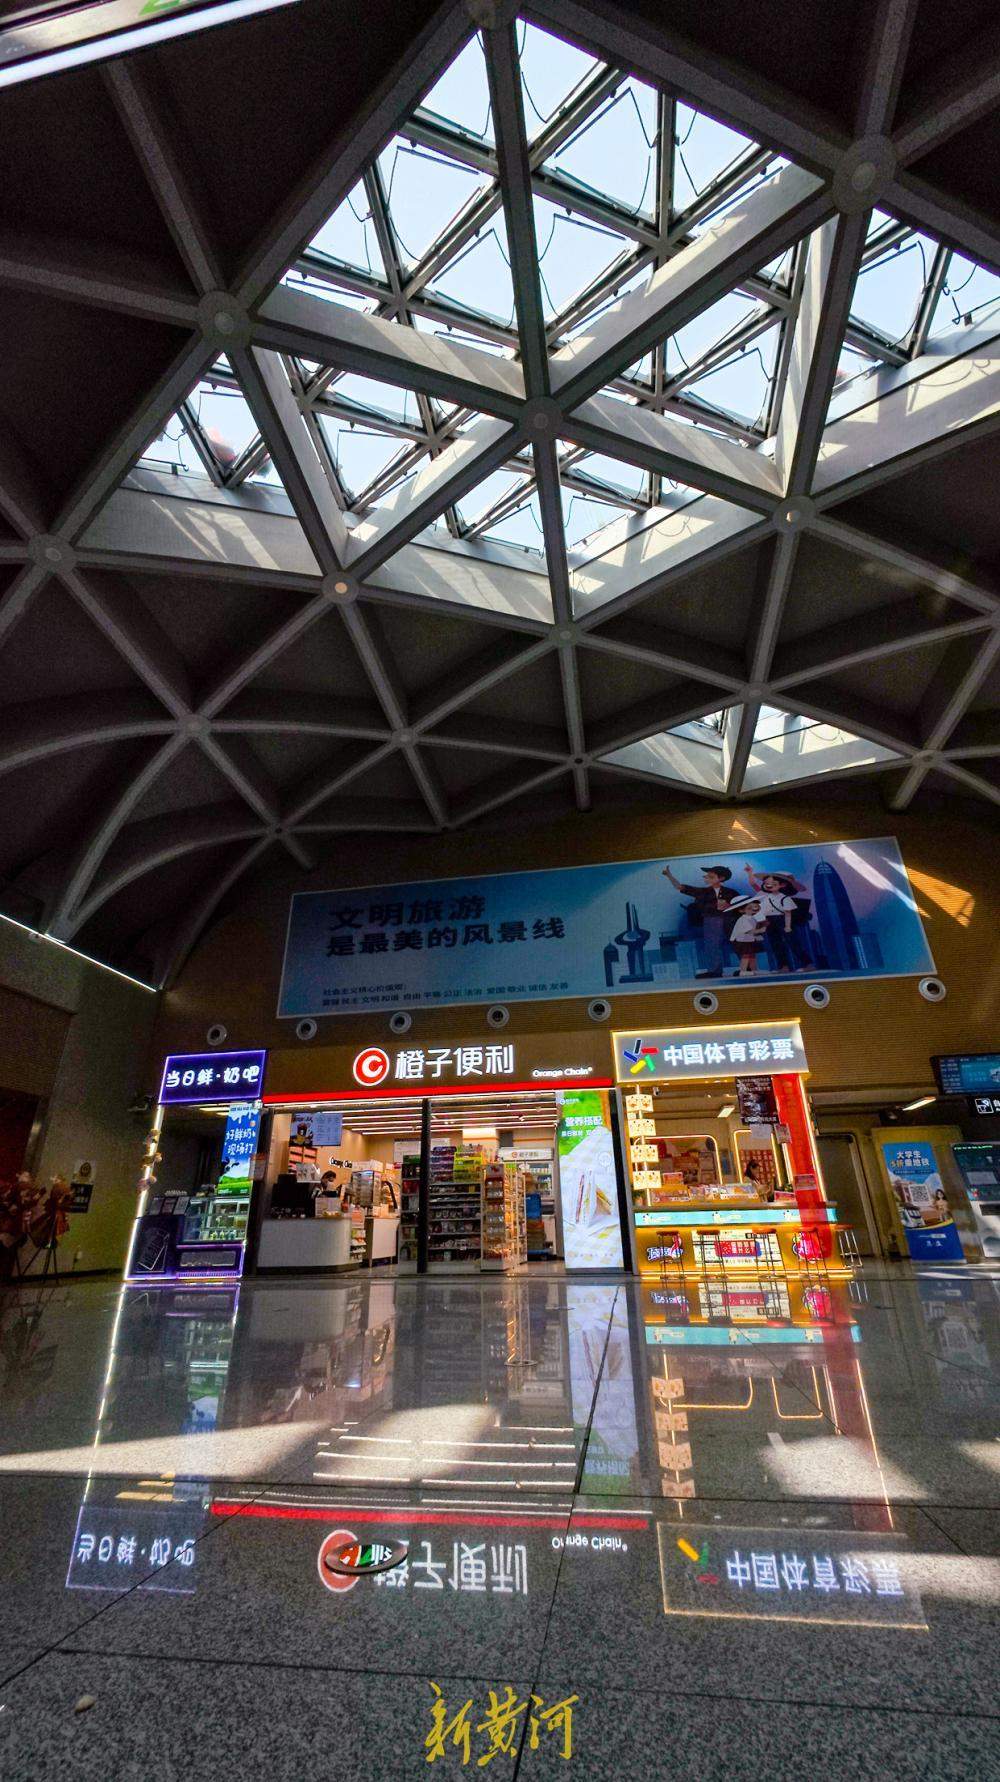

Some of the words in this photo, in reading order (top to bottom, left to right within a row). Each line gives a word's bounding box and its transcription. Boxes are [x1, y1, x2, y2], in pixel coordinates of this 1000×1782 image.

[329, 896, 486, 931] 文明旅游
[326, 917, 566, 957] 是最美的风景线
[394, 1045, 514, 1079] 橙子便利
[663, 1038, 795, 1067] 中国体育彩票
[165, 1065, 260, 1088] 当日鲜·奶吧
[532, 1069, 563, 1078] Orange
[896, 1150, 922, 1159] 大学生
